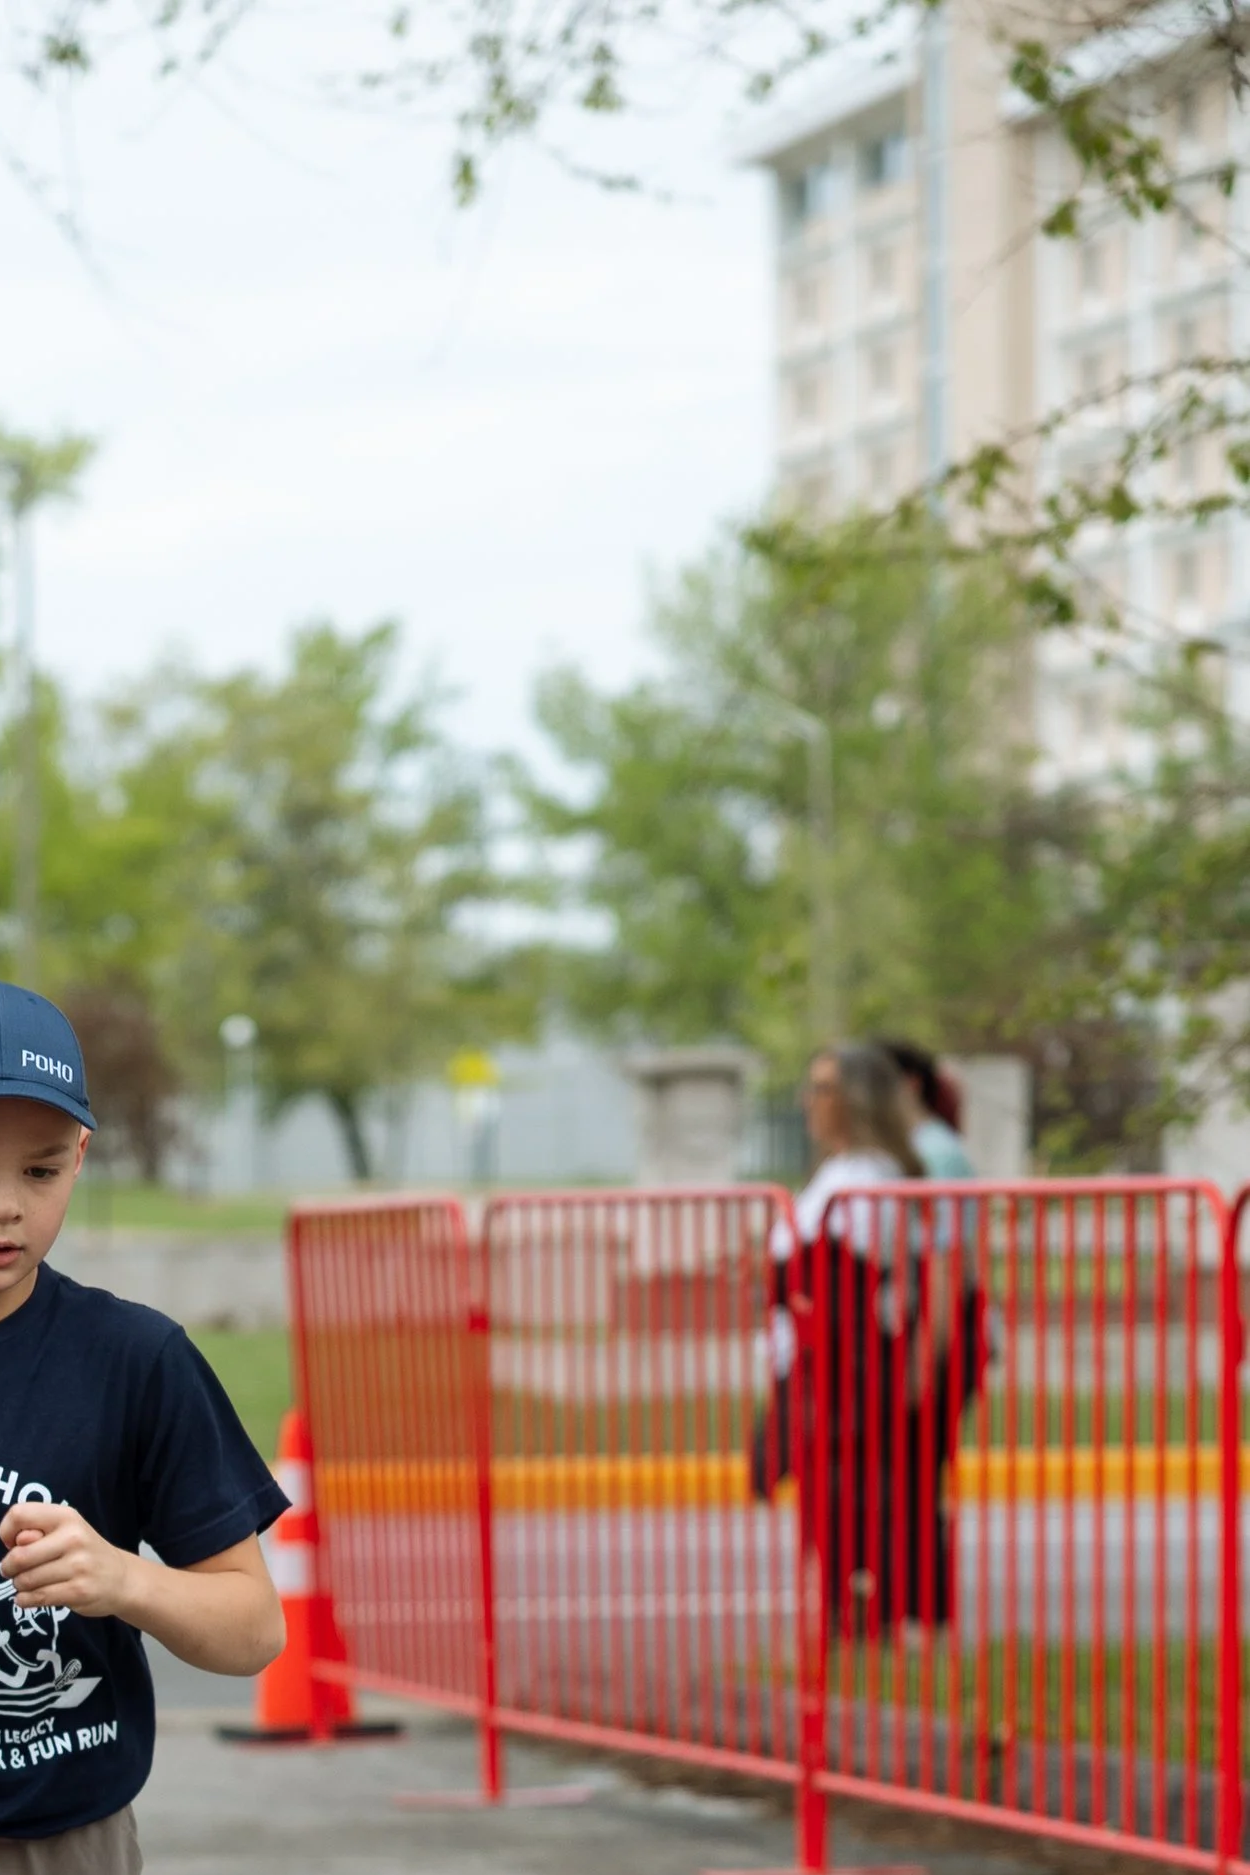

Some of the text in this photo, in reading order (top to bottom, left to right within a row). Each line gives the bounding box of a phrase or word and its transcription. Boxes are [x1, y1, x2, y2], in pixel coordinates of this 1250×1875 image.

[22, 1049, 73, 1083] POHO
[4, 1717, 55, 1744] LEGACY
[10, 1748, 26, 1769] &
[28, 1732, 73, 1766] FUN
[76, 1721, 119, 1750] RUN
